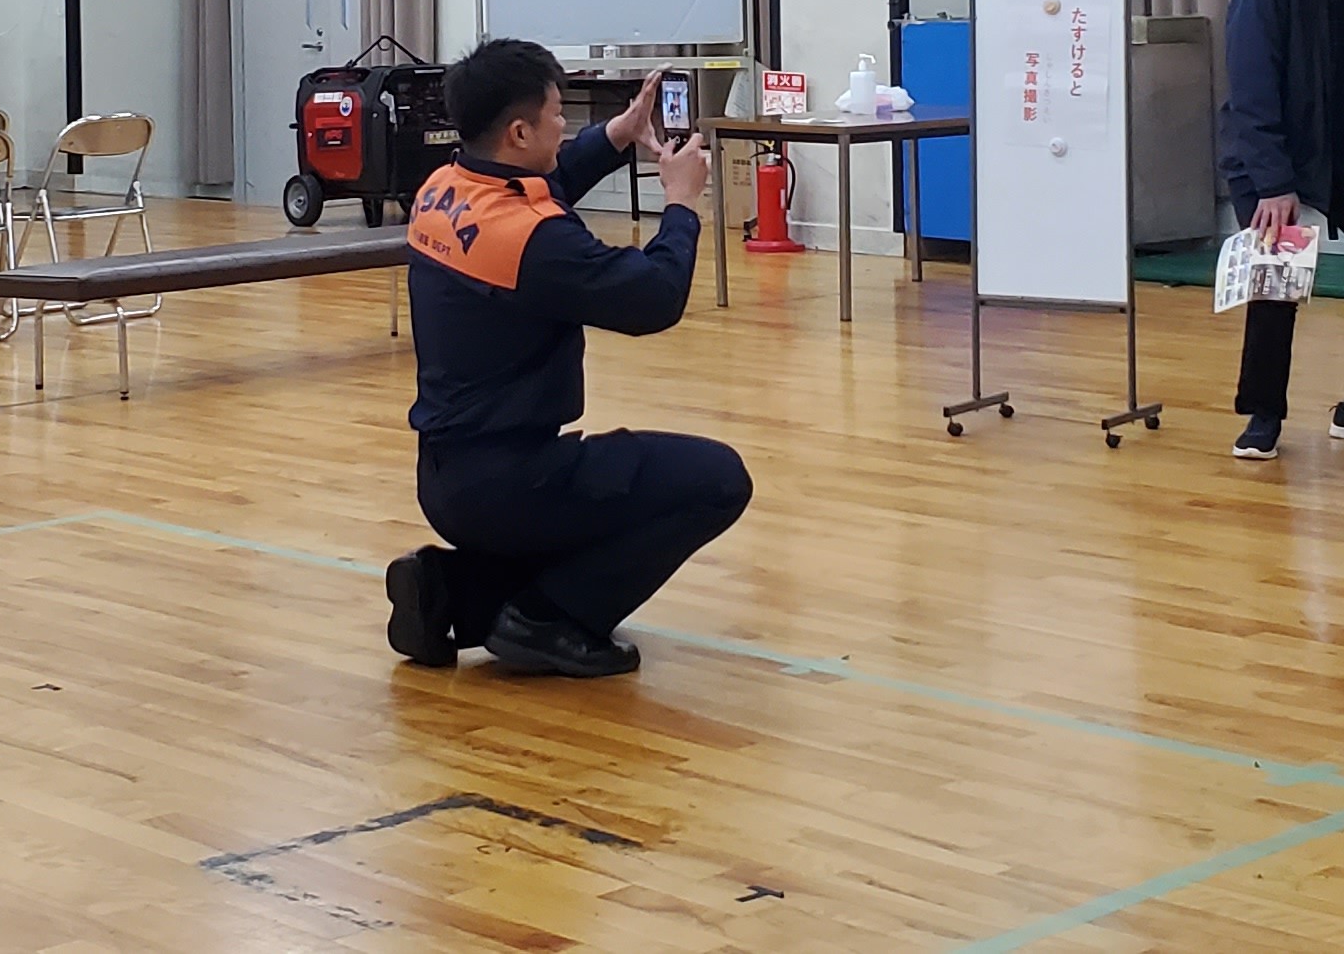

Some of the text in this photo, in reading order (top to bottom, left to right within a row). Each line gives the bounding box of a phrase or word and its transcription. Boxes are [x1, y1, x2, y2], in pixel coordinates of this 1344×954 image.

[1024, 52, 1040, 121] 写真撮影
[1070, 7, 1087, 97] たすけると
